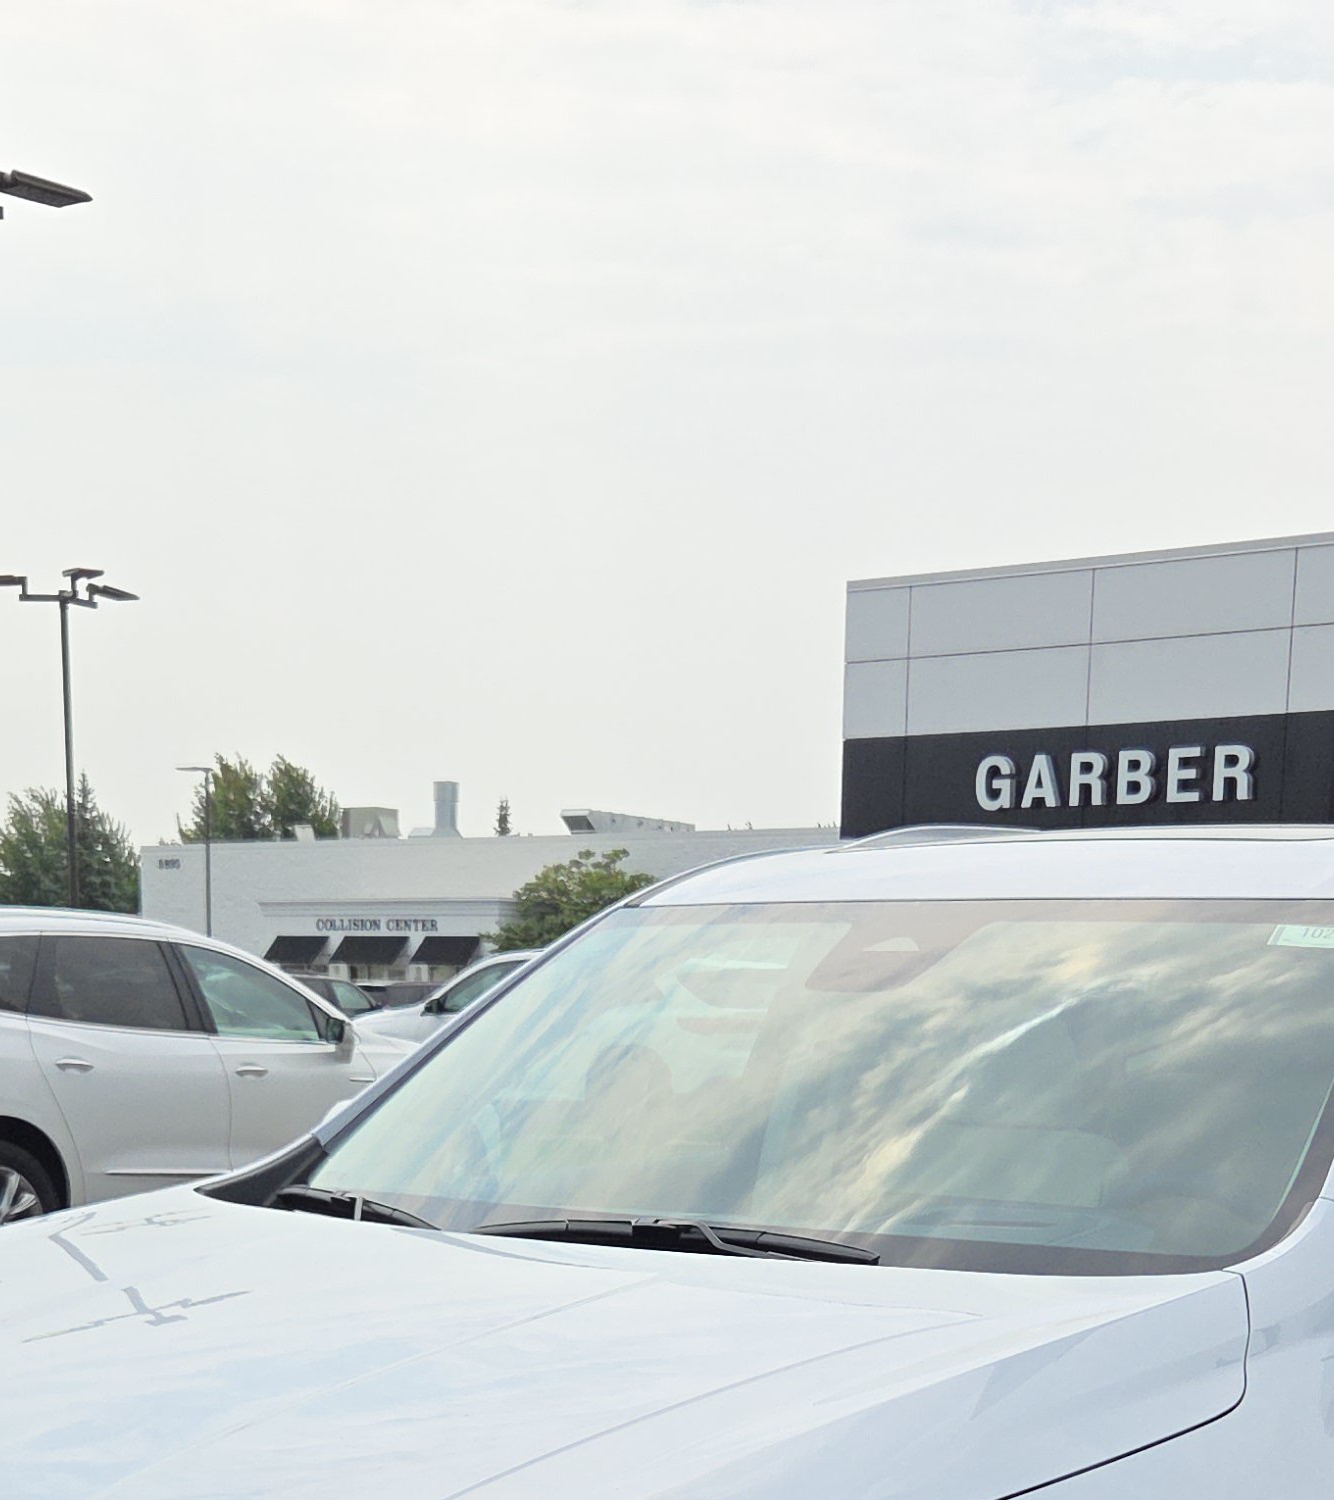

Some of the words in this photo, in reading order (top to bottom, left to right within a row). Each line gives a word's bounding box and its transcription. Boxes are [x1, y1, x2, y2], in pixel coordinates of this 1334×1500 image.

[975, 744, 1254, 811] GARBER
[315, 918, 381, 932] COLLISION
[386, 918, 438, 932] CENTER
